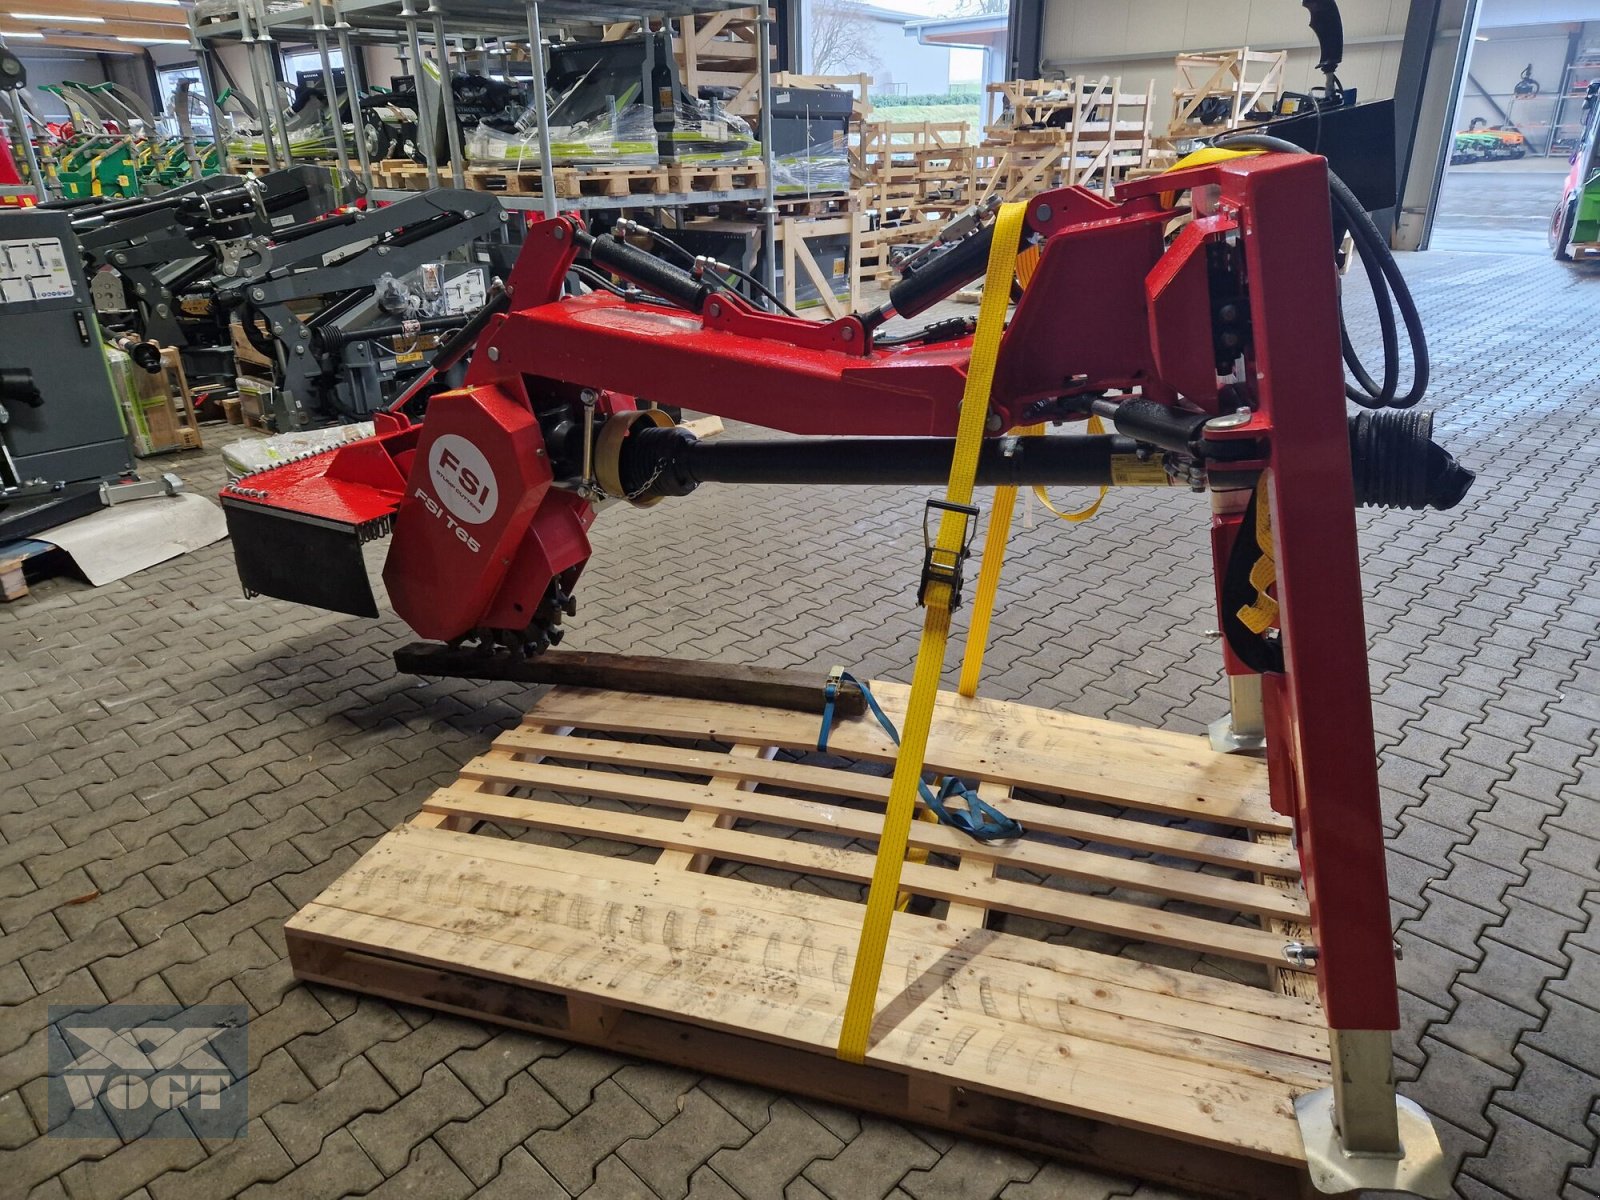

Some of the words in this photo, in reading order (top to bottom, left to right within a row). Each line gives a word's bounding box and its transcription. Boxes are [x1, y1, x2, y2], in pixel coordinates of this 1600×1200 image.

[436, 470, 456, 489] STUMP
[455, 488, 481, 514] CUTTERS
[439, 448, 490, 506] FSI
[414, 488, 444, 519] FSI
[446, 515, 481, 553] T65
